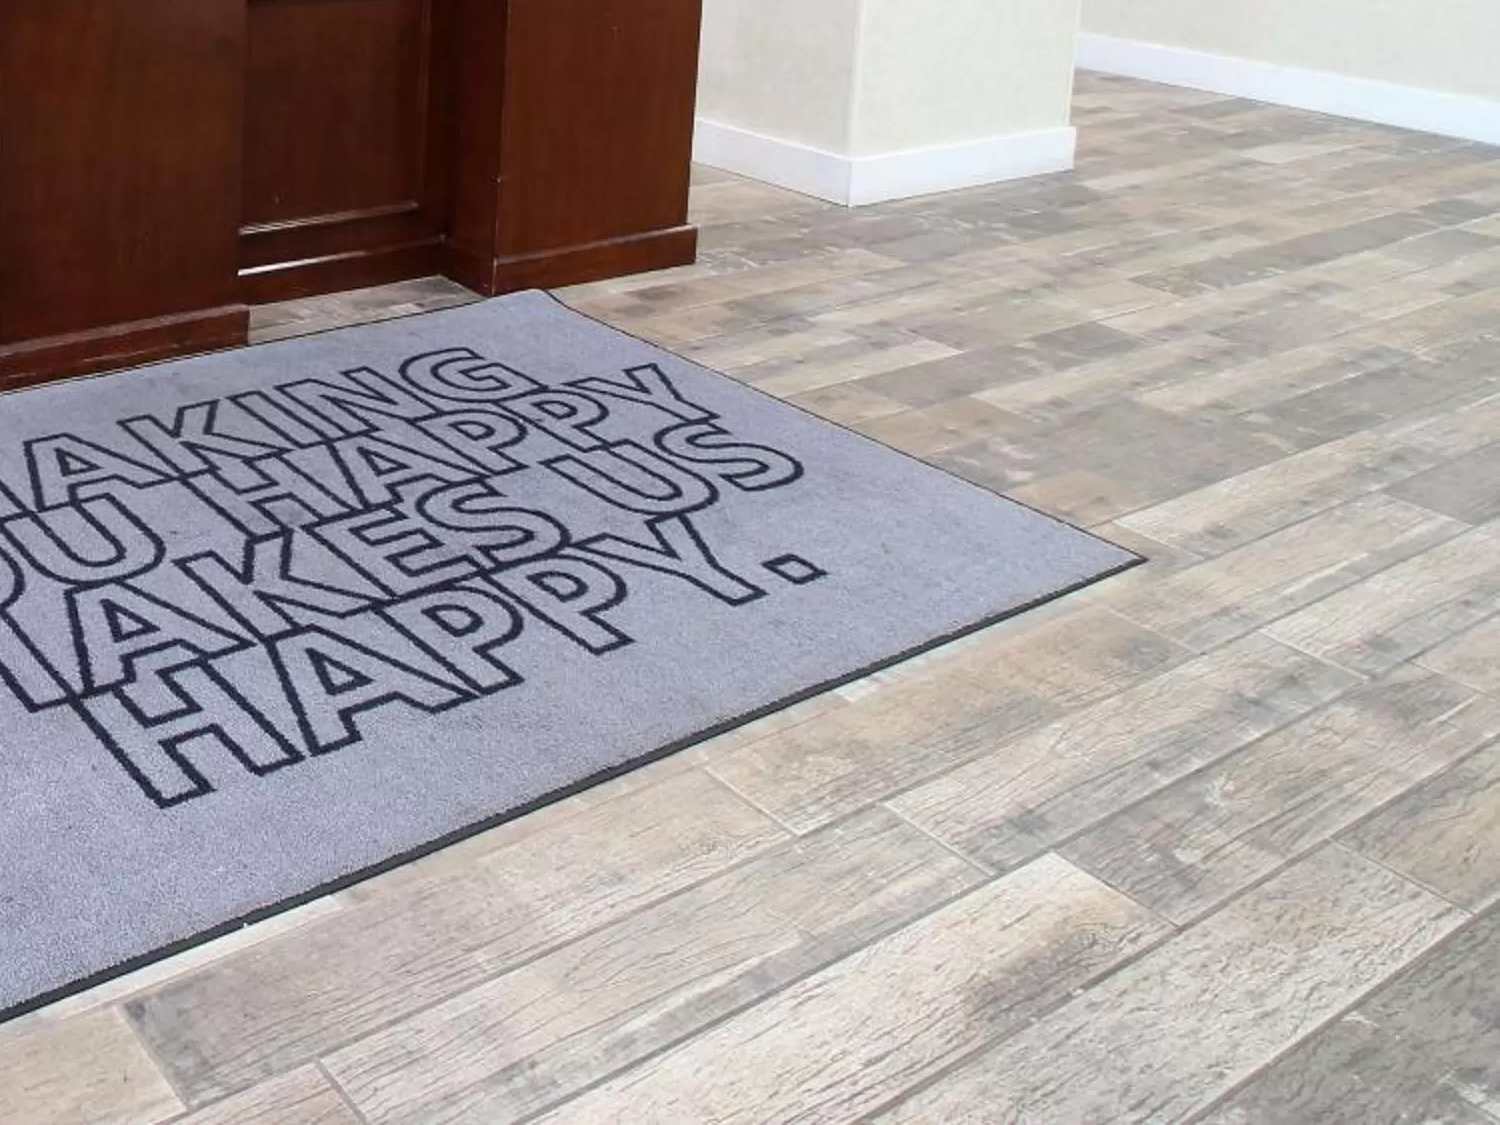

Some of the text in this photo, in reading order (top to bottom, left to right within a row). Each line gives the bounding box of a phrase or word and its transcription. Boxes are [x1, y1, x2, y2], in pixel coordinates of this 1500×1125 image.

[172, 363, 720, 539] HAPPY
[540, 419, 804, 516] US
[68, 515, 828, 809] HAPPY.
